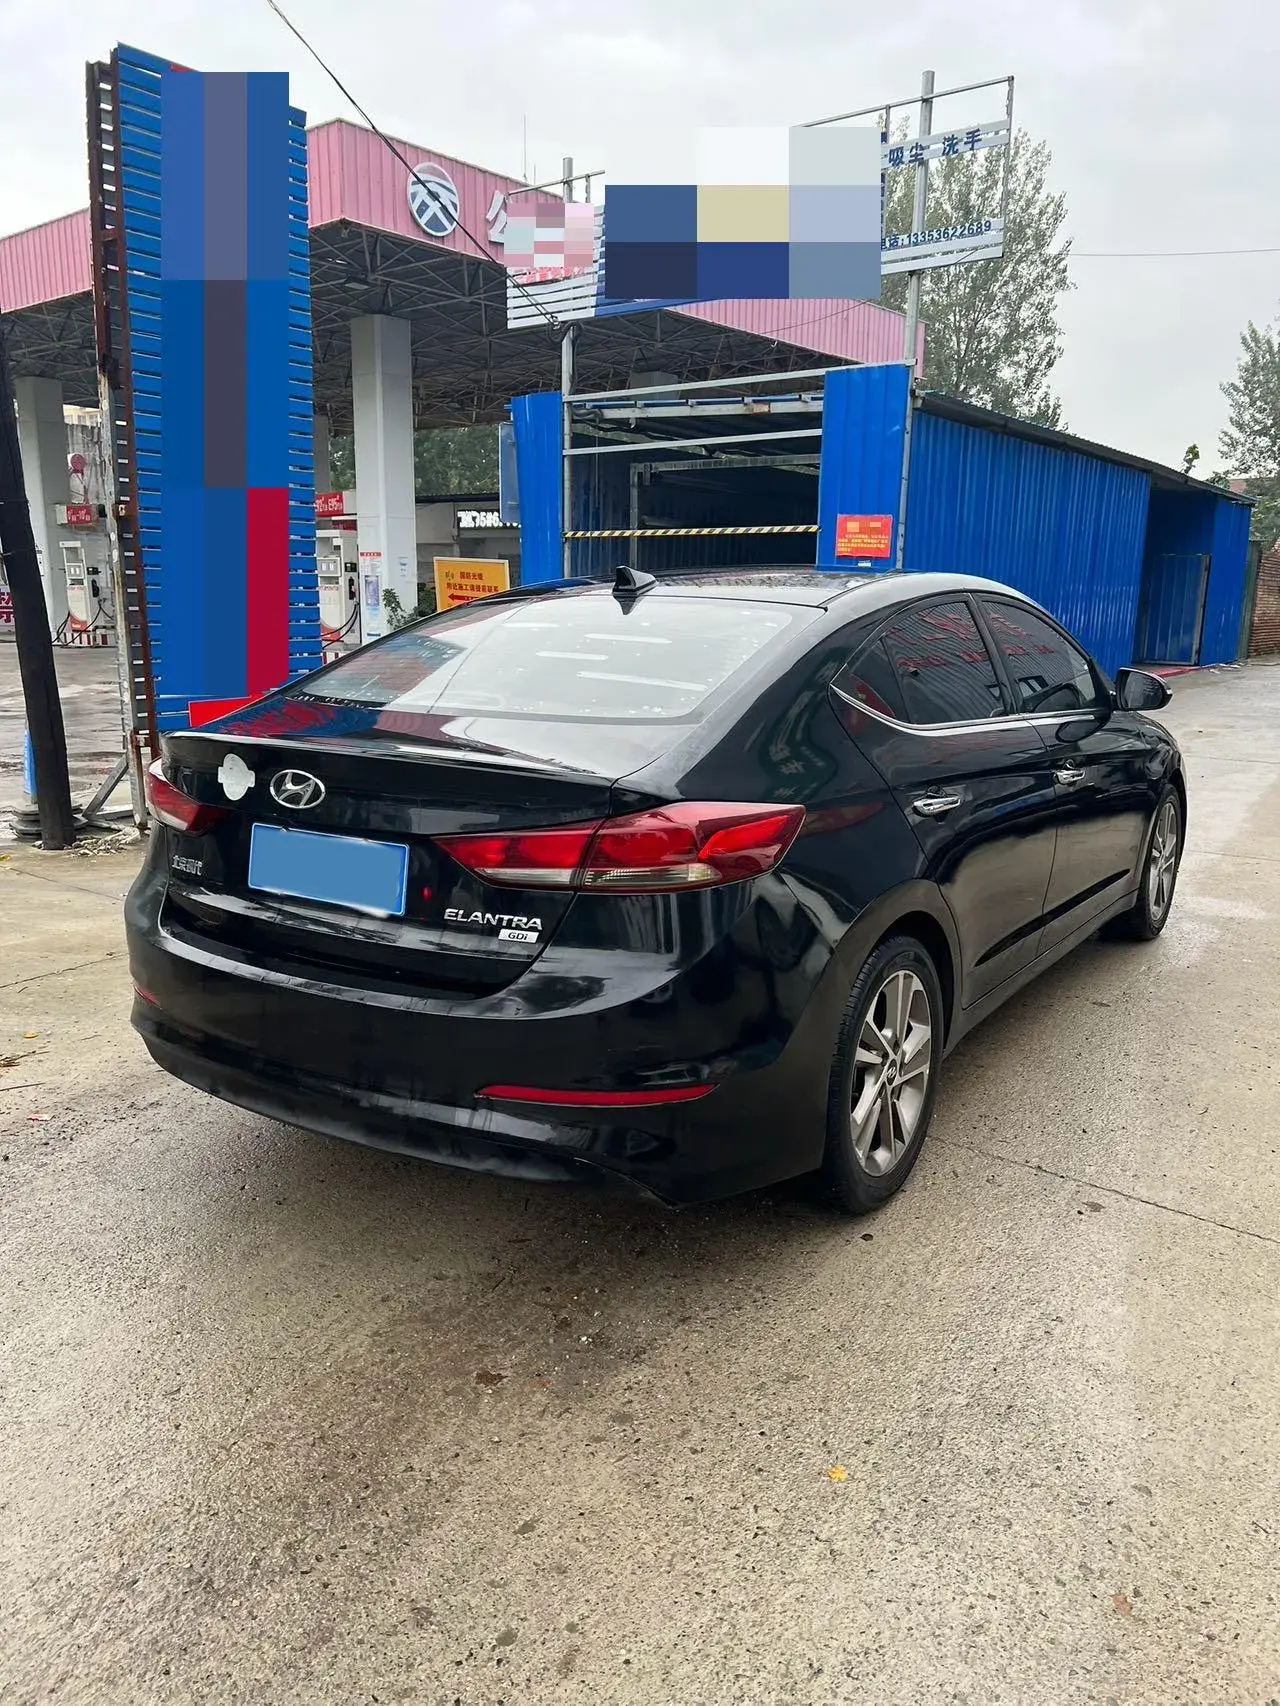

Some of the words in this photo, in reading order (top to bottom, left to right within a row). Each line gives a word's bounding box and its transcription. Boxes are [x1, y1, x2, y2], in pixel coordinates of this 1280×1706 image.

[888, 142, 925, 167] 吸尘
[172, 855, 203, 876] 北京现代
[444, 908, 543, 930] ELANTRA
